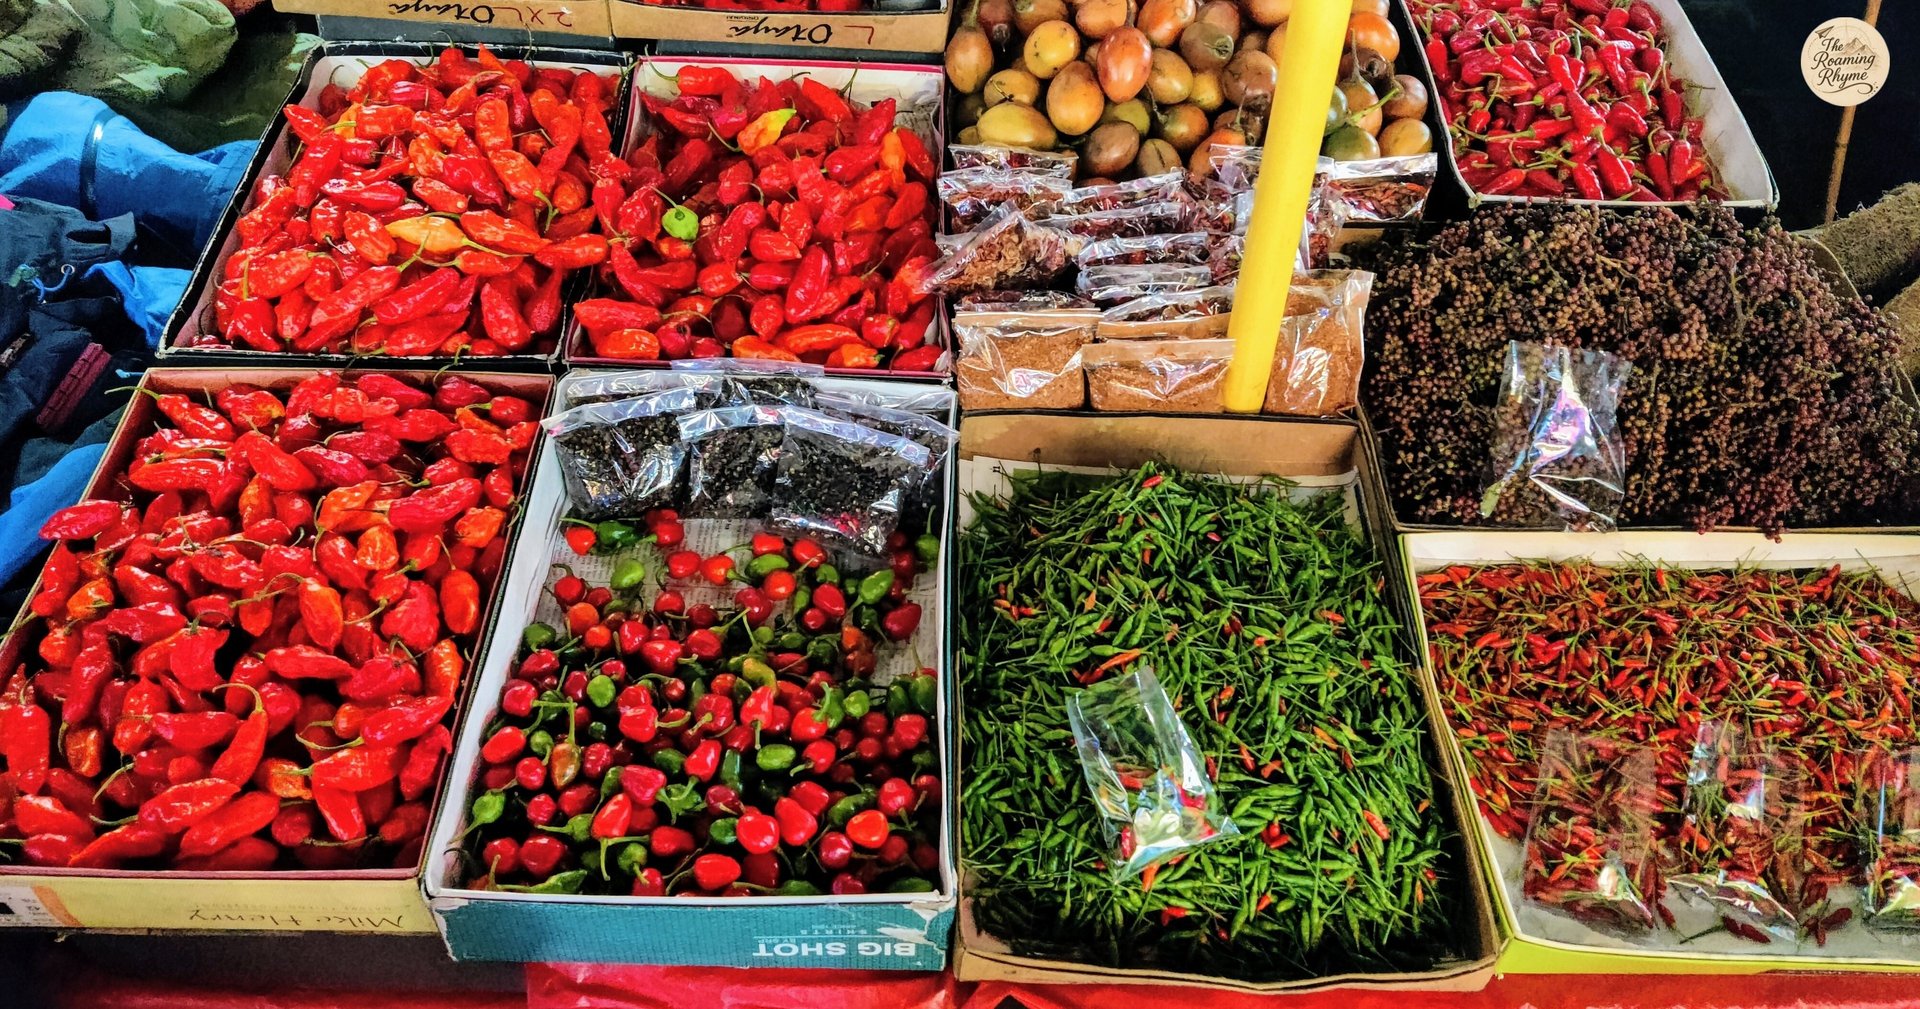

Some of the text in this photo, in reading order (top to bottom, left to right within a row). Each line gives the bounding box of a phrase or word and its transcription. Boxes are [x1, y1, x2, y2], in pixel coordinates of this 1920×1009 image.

[388, 0, 495, 24] Otaya
[729, 17, 833, 44] Otaya
[189, 909, 403, 929] Mike Henry
[752, 942, 916, 957] BIG SHOT
